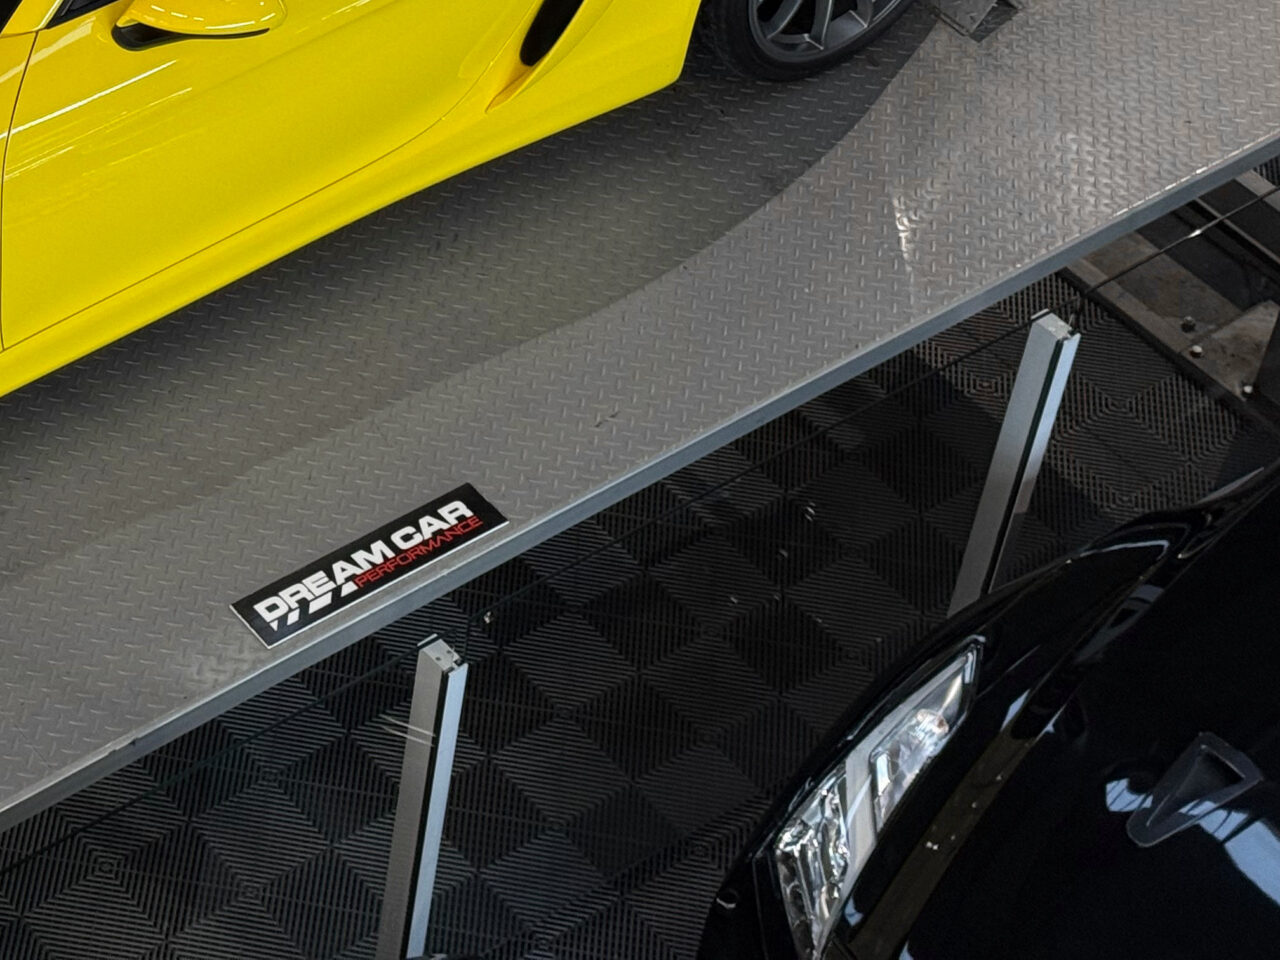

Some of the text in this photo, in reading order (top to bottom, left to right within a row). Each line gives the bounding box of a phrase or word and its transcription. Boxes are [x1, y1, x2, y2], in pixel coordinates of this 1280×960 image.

[253, 500, 474, 623] DREAM CAR
[354, 515, 484, 588] PERFORMANCE
